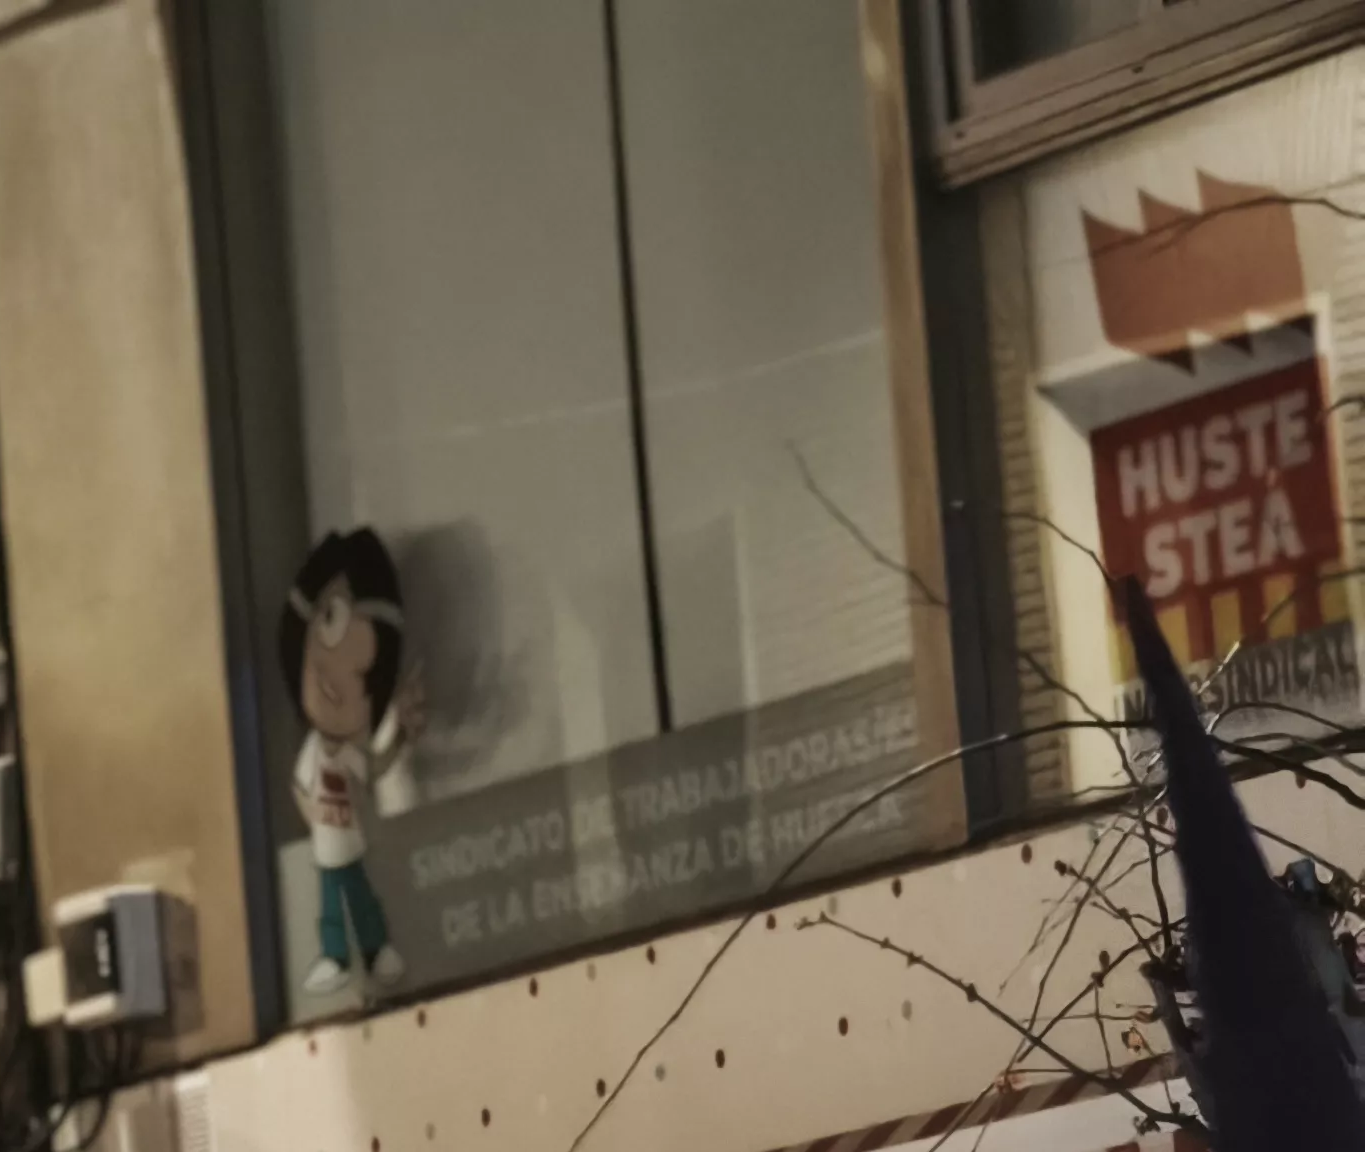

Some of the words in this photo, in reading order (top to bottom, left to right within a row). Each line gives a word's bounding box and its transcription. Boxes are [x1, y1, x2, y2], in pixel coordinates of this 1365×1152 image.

[1116, 389, 1313, 519] HUSTE
[409, 810, 564, 890] SINDICATO
[441, 900, 484, 947] DE
[486, 886, 526, 935] LA
